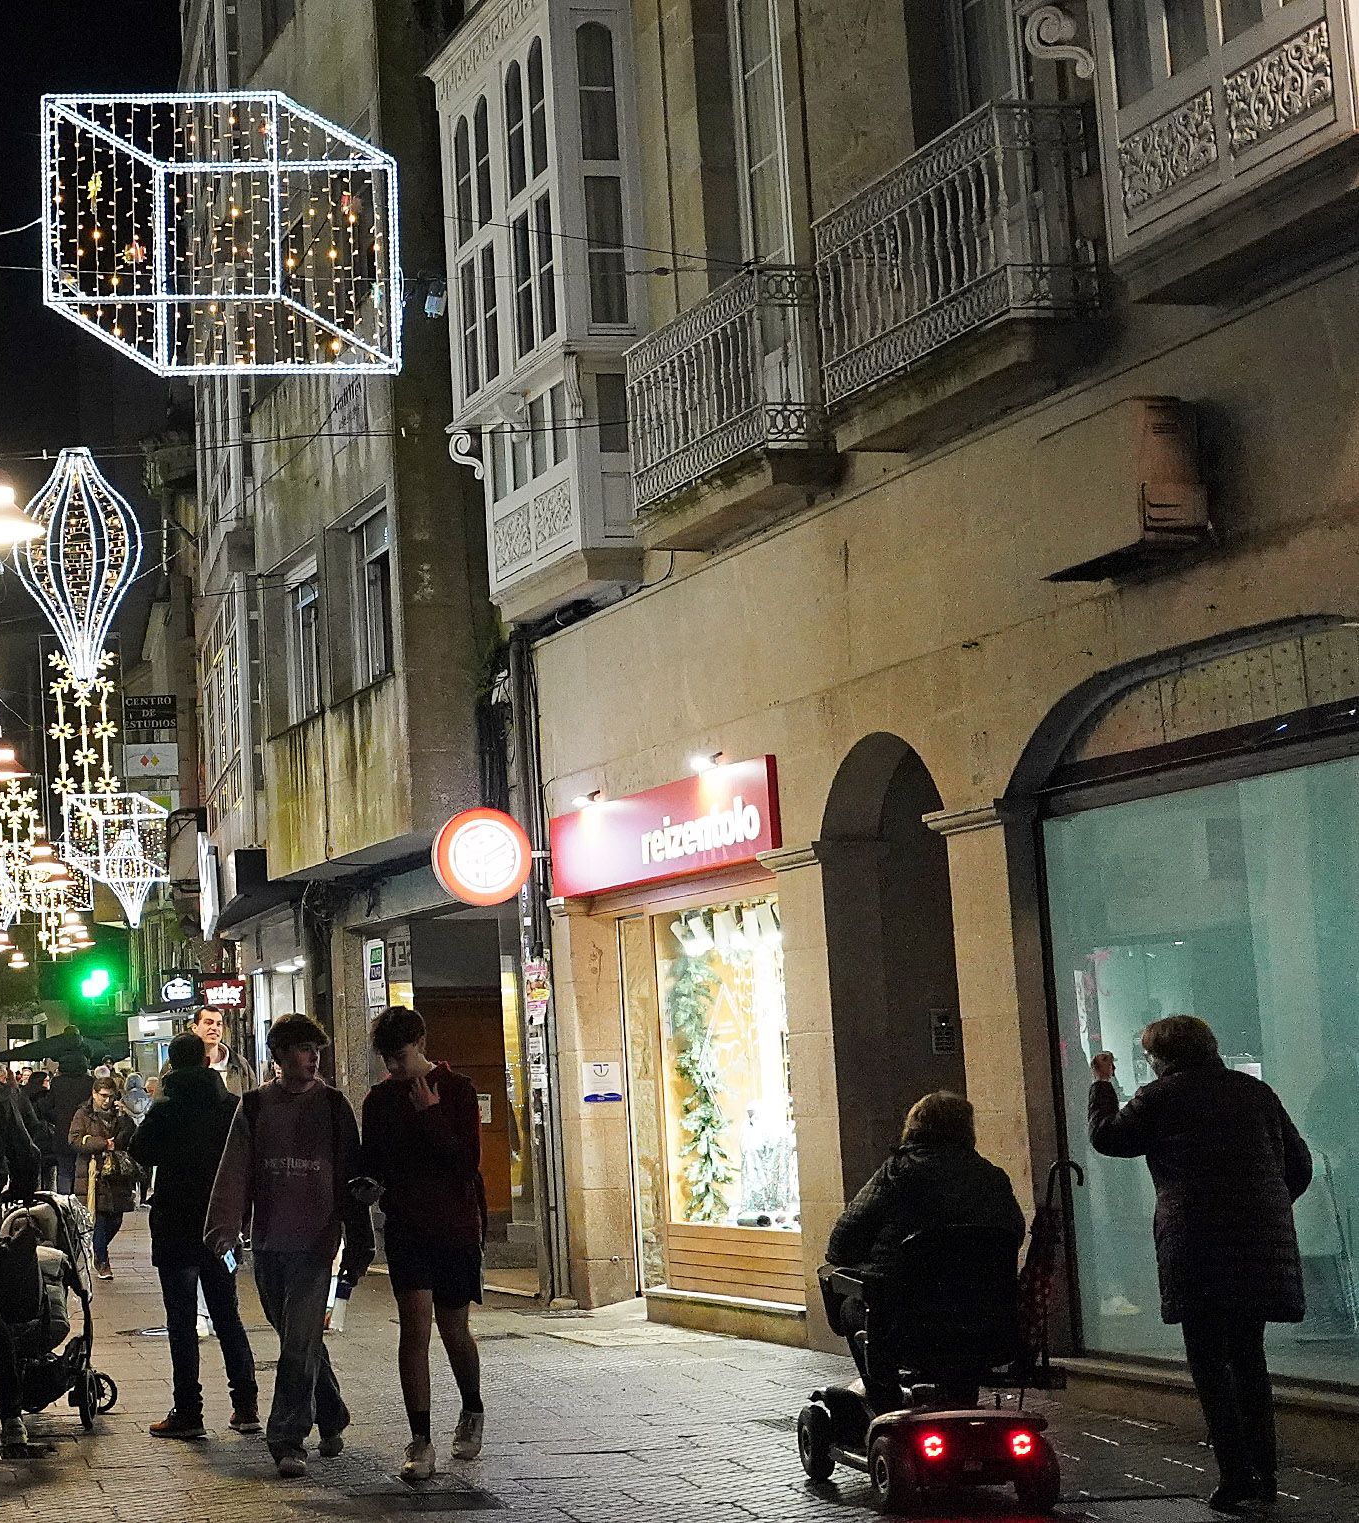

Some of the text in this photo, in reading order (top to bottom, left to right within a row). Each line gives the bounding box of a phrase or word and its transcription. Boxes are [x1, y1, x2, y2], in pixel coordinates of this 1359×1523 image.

[125, 696, 172, 706] CENTRO
[142, 708, 156, 718] DE
[124, 719, 176, 729] ESTUDIOS
[641, 795, 761, 865] reizentolo
